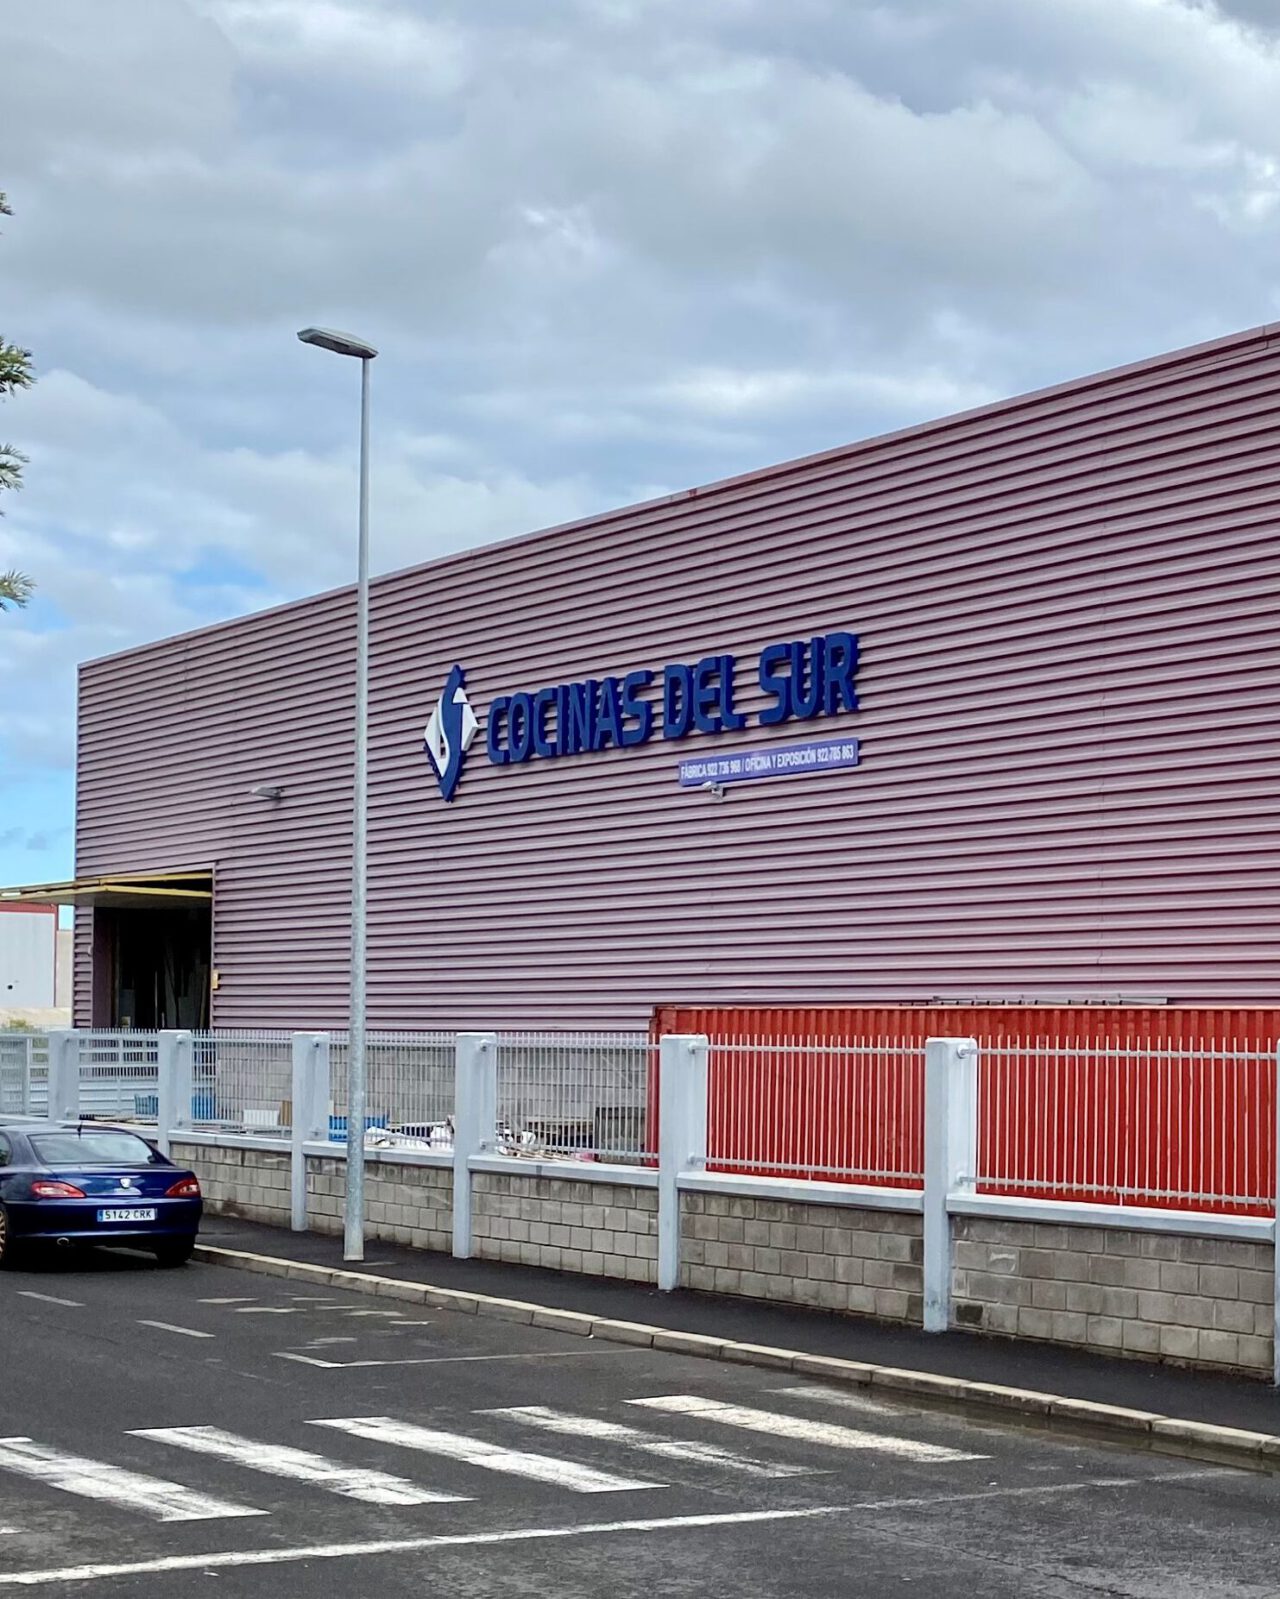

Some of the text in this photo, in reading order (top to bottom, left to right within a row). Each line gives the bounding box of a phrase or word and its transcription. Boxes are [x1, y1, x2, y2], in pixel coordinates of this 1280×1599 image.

[487, 632, 858, 765] COCINAS DEL SUR
[681, 762, 708, 780] FÁBRICA
[745, 755, 772, 772] OFICINA
[772, 755, 777, 768] Y
[777, 747, 816, 768] EXPOSICIÓN
[817, 748, 828, 763] 922
[105, 1209, 151, 1219] 5142 CRK
